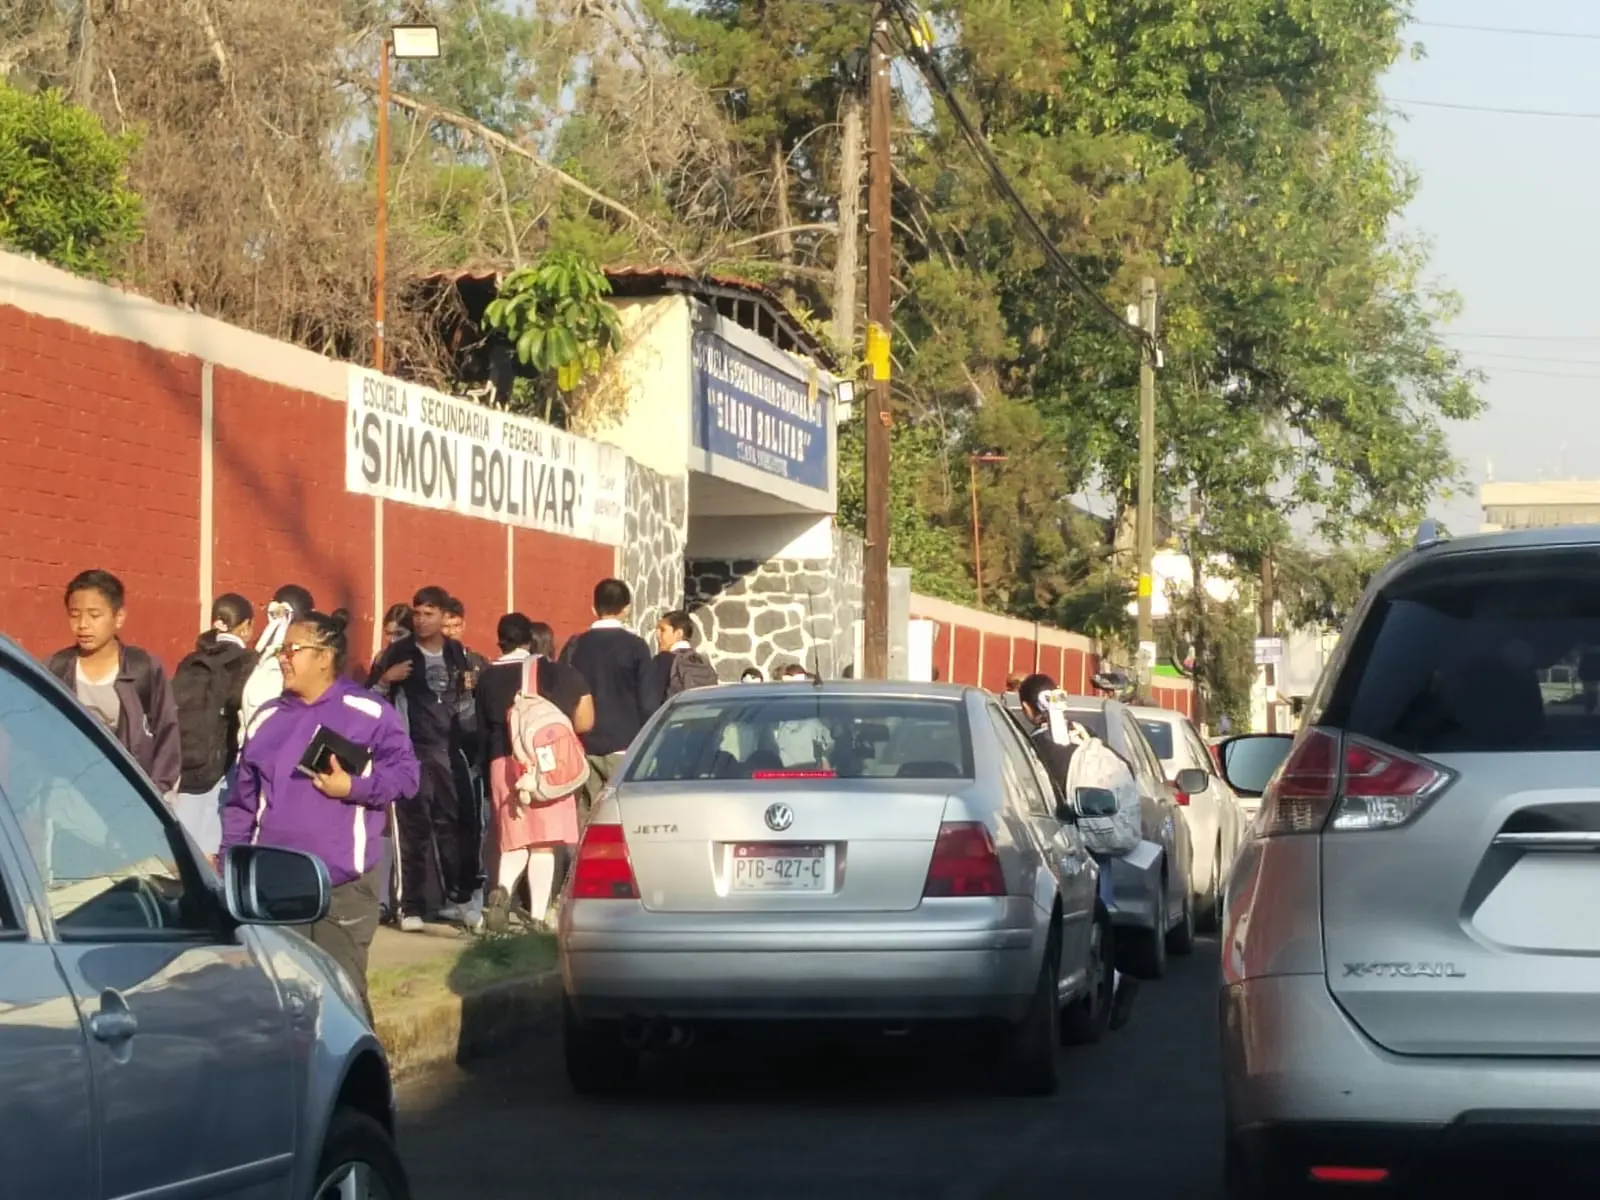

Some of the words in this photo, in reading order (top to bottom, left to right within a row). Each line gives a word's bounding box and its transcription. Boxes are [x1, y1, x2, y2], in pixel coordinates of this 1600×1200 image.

[363, 376, 408, 418] ESCUELA
[420, 396, 490, 442] SECUNDARIA
[502, 422, 543, 457] FEDERAL
[633, 824, 679, 835] JETTA
[1342, 961, 1467, 978] X-TRAIL
